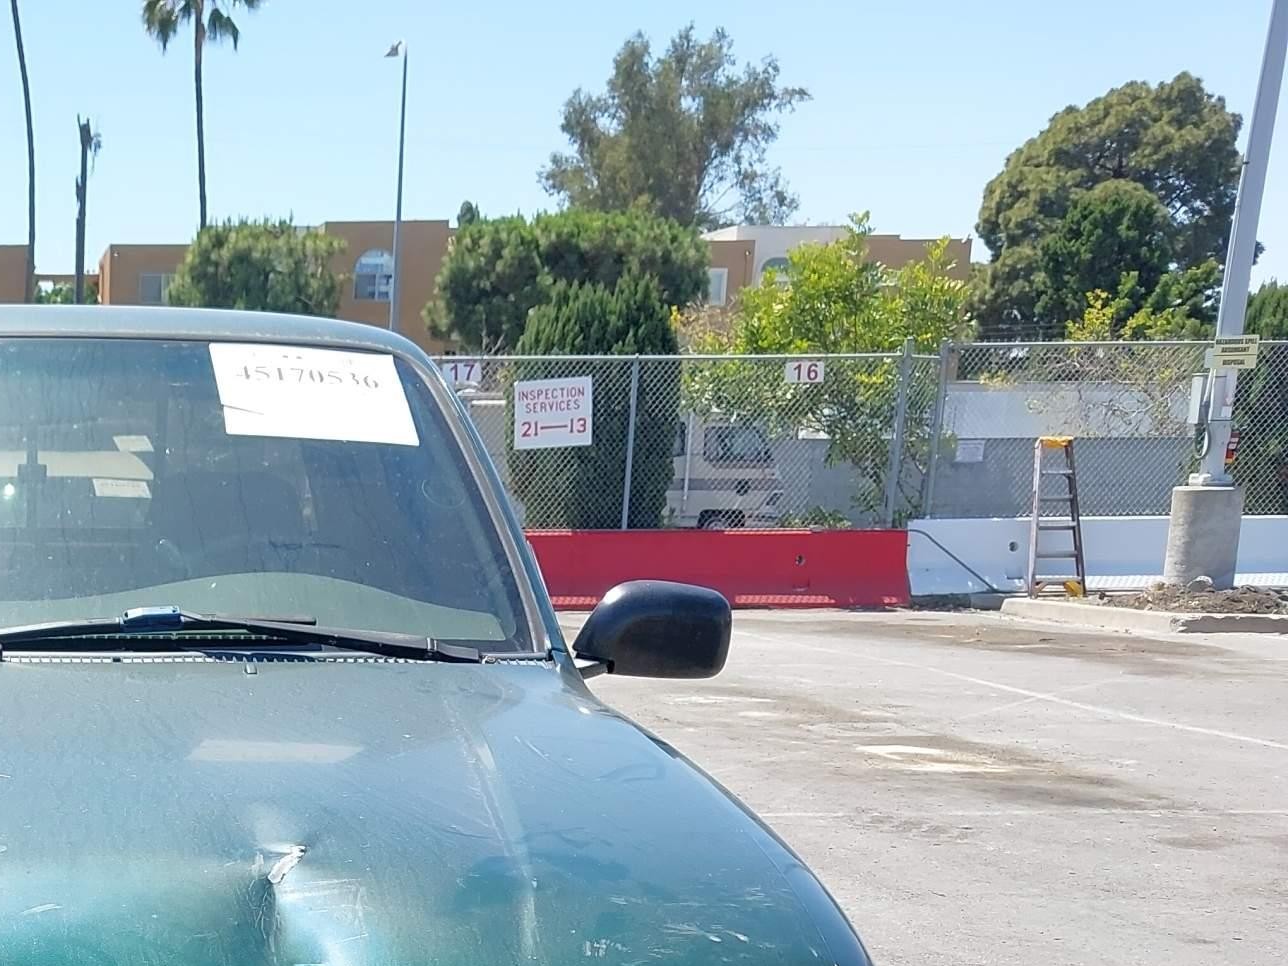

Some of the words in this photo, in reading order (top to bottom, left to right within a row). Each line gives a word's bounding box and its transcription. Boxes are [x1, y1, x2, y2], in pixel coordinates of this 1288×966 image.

[235, 365, 381, 389] 45170536
[450, 363, 475, 381] 17
[793, 363, 819, 381] 16
[518, 386, 585, 402] INSPECTION
[524, 399, 581, 414] SERVICES
